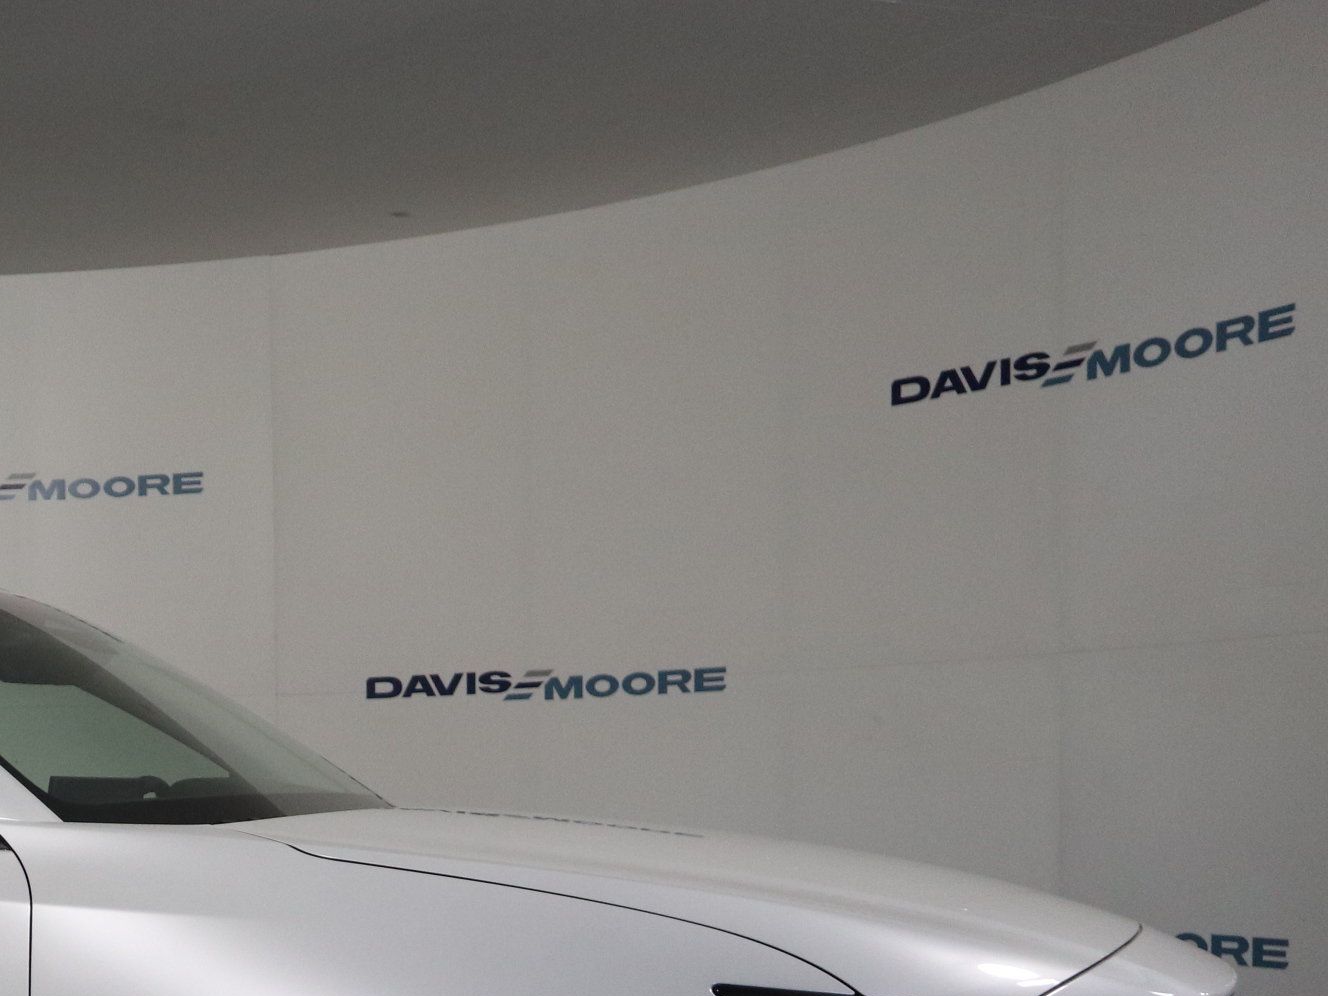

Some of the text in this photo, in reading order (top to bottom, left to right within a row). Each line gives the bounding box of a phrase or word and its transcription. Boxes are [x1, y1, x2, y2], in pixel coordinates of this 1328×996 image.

[890, 302, 1297, 407] DAVIS MOORE
[27, 471, 204, 501] MOORE
[365, 666, 728, 701] DAVIS MOORE
